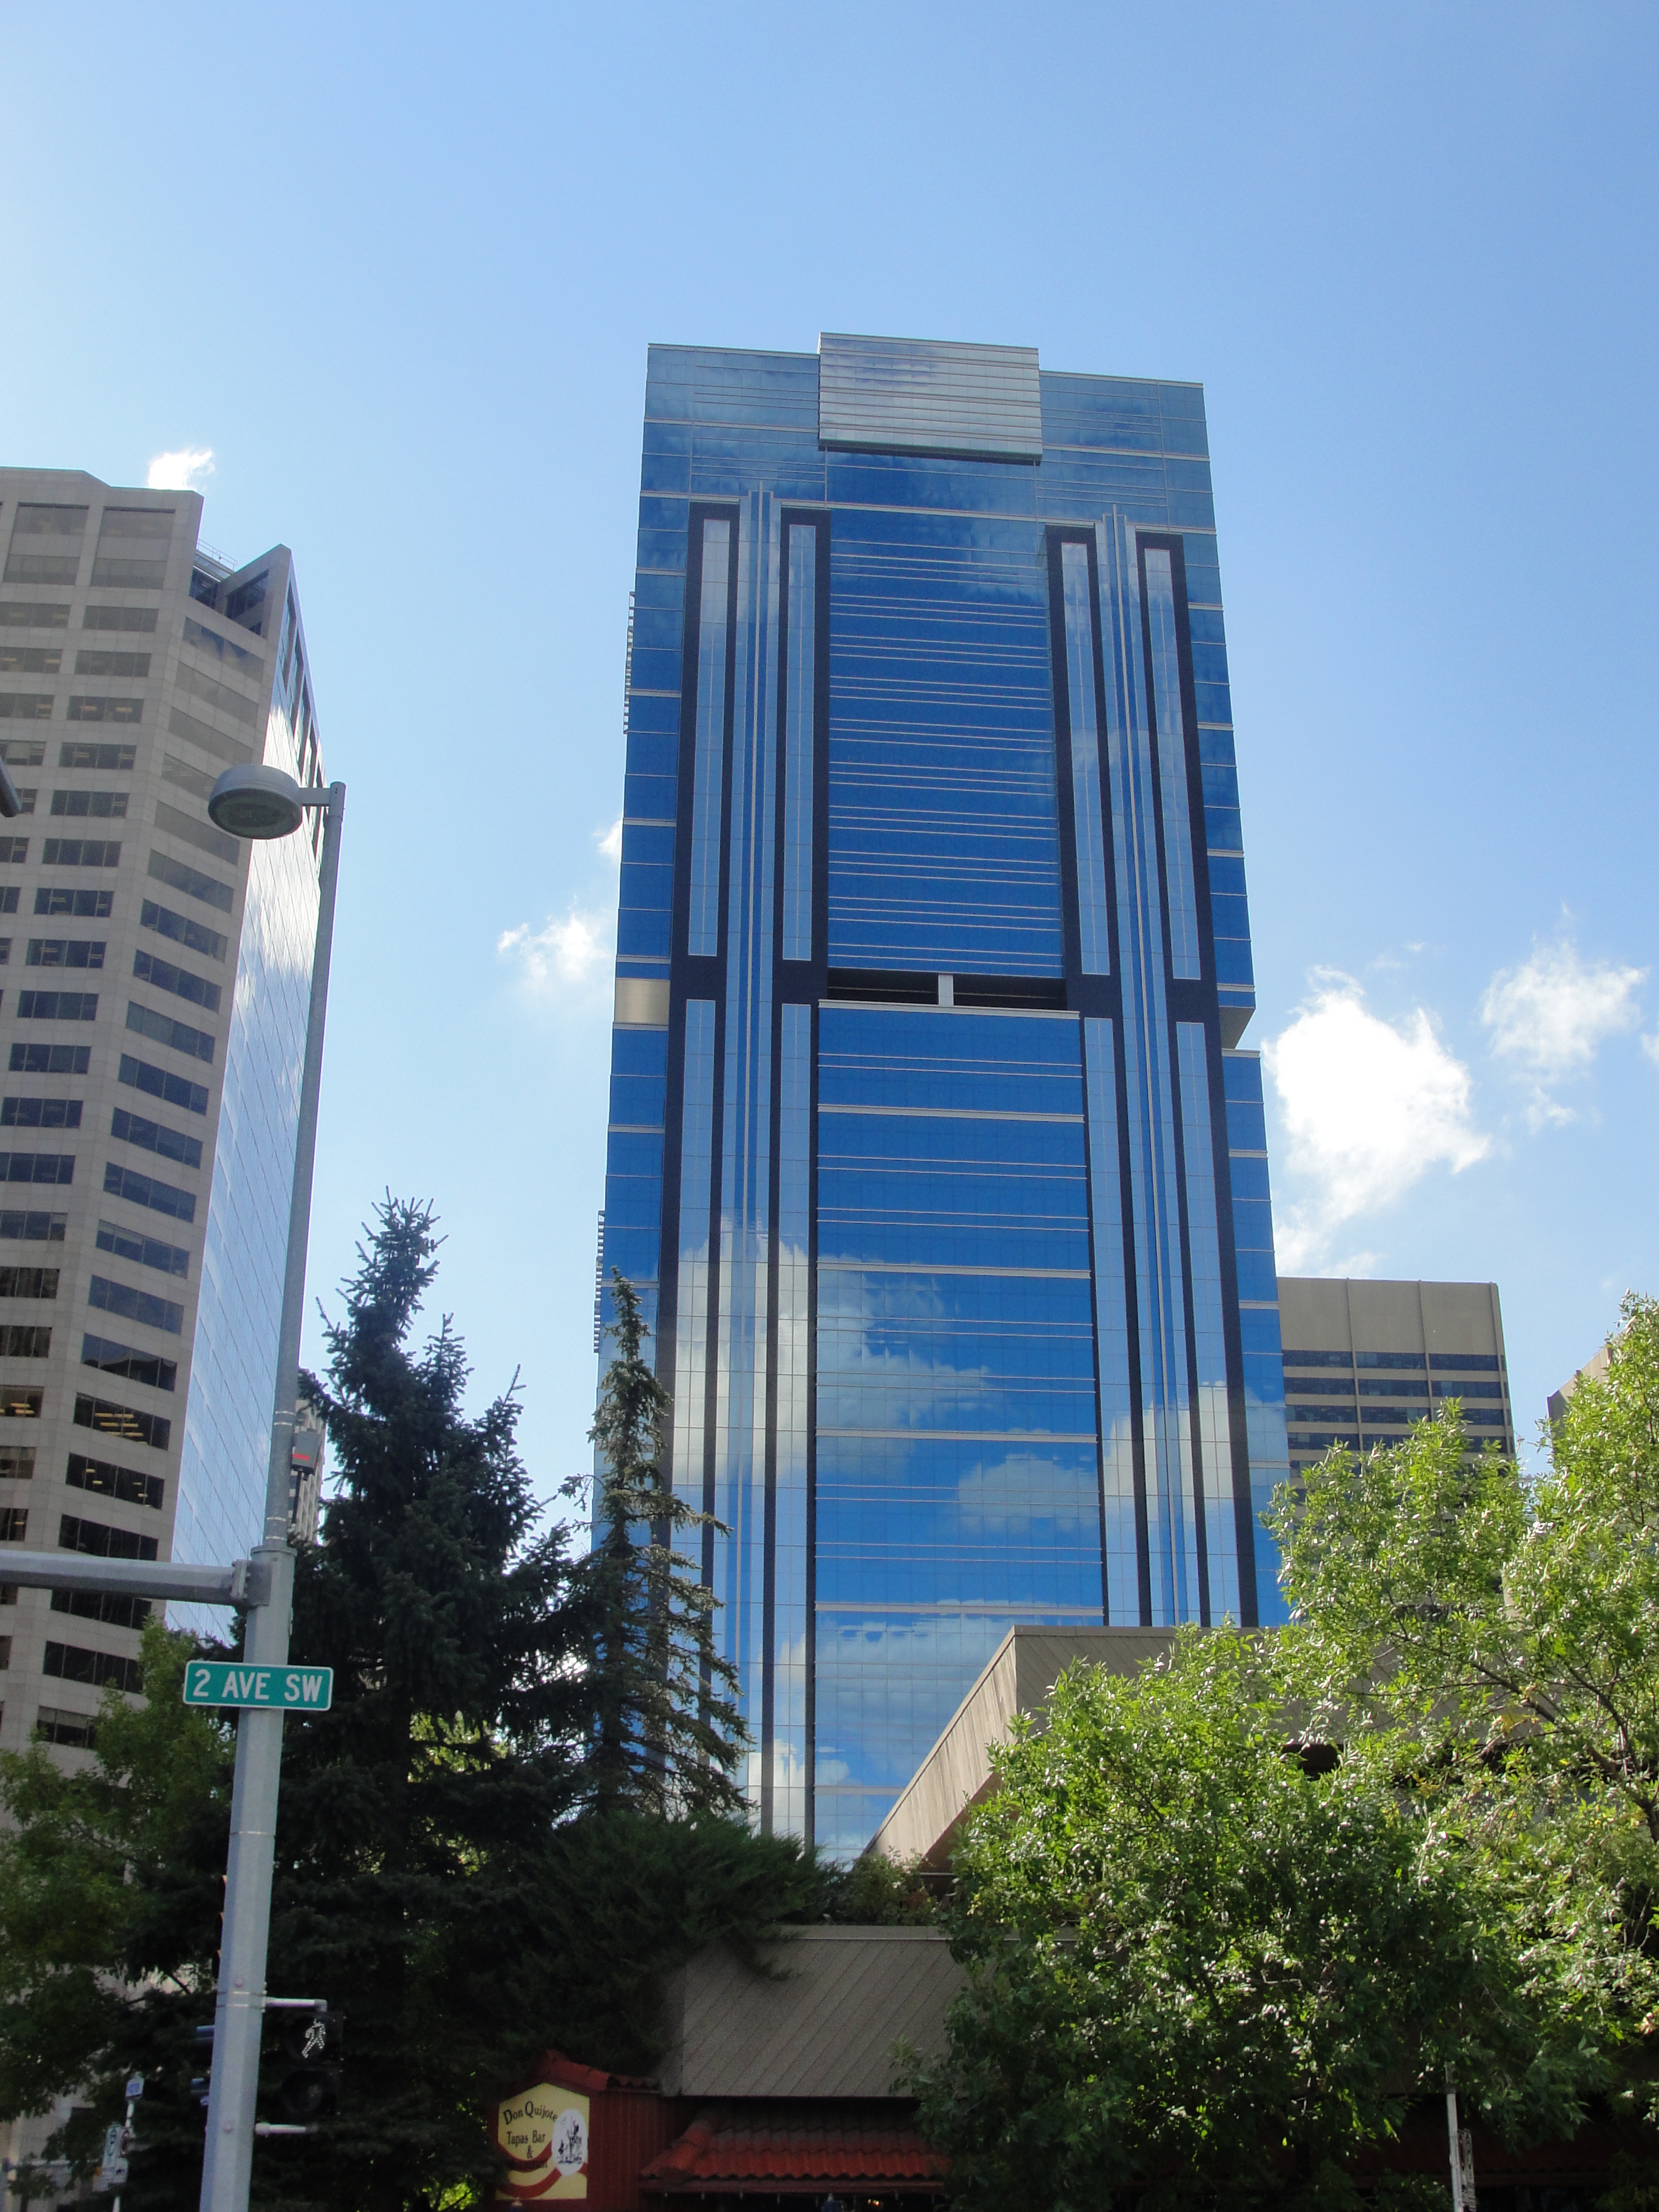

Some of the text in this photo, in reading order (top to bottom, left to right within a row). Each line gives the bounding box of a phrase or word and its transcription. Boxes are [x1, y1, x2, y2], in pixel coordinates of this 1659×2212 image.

[192, 1668, 323, 1702] 2 AVE SW
[503, 2100, 558, 2125] Don Quijote
[506, 2130, 546, 2147] Tapas Bar
[526, 2145, 533, 2159] &
